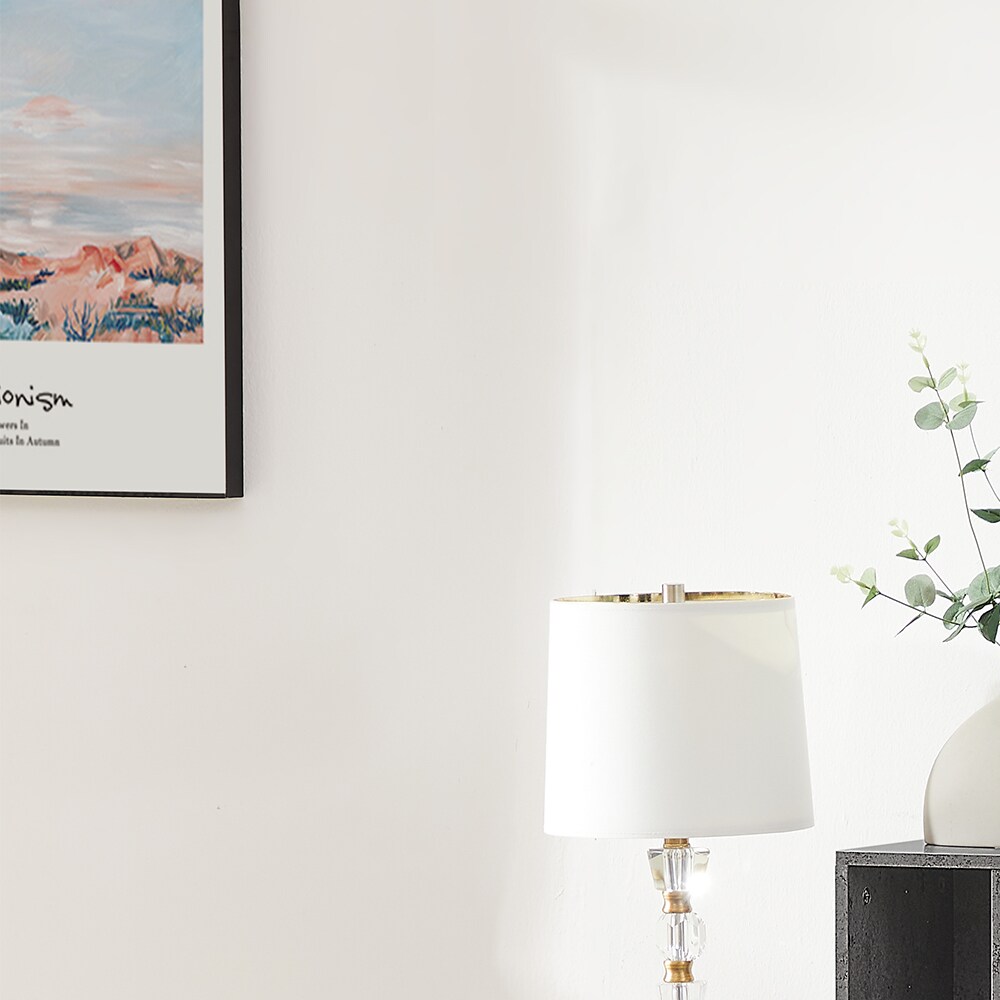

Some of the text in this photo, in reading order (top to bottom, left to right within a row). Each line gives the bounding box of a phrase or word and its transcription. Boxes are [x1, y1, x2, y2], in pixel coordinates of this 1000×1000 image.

[0, 385, 73, 412] onism
[20, 419, 29, 430] In
[16, 435, 25, 445] In
[26, 436, 60, 446] Autumn
